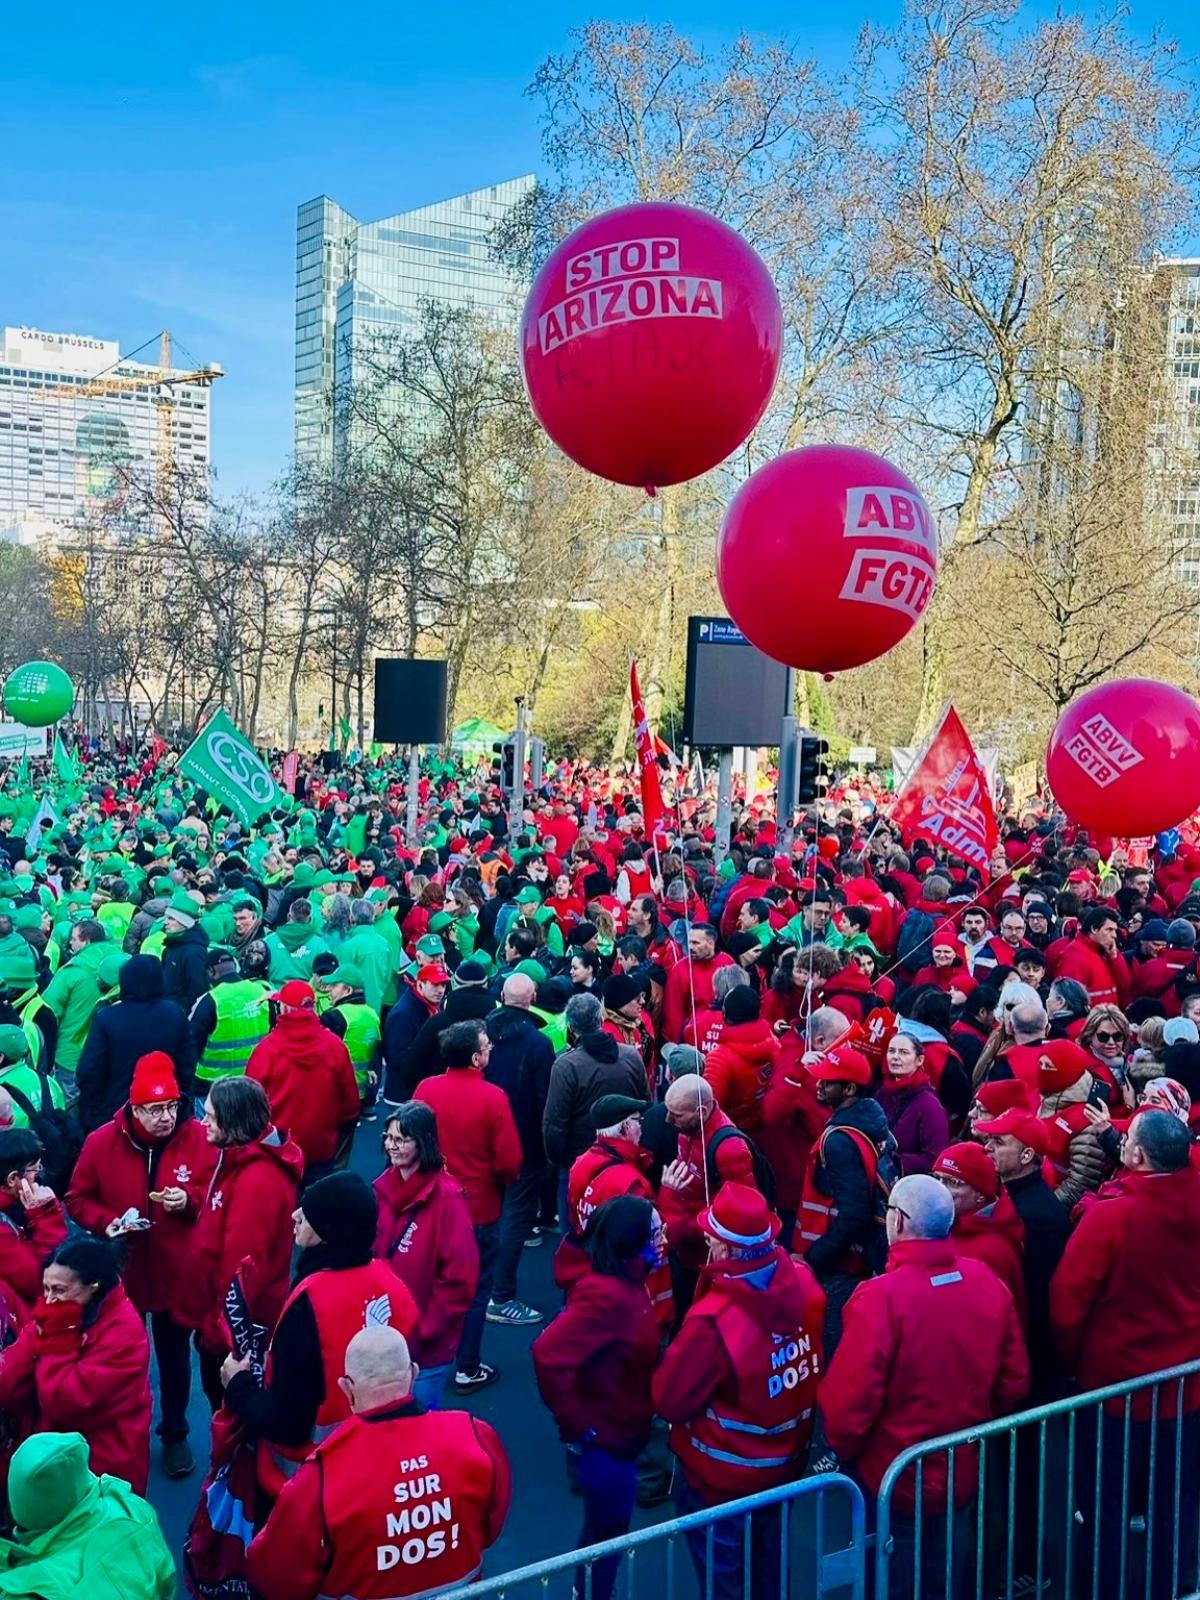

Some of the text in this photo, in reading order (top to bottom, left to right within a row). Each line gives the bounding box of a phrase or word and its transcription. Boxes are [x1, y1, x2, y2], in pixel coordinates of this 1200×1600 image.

[570, 240, 677, 288] STOP
[544, 279, 720, 351] ARIZONA
[21, 331, 105, 350] CARDO BRUSSELS
[857, 493, 931, 539] ABV
[1070, 737, 1112, 782] FGTB
[1087, 719, 1136, 763] ABVV
[213, 738, 270, 798] CSC
[702, 1040, 719, 1052] MO
[706, 1030, 720, 1040] SU
[771, 1334, 811, 1370] MON
[400, 1455, 428, 1474] PAS
[393, 1473, 441, 1503] SUR
[386, 1497, 452, 1538] MON
